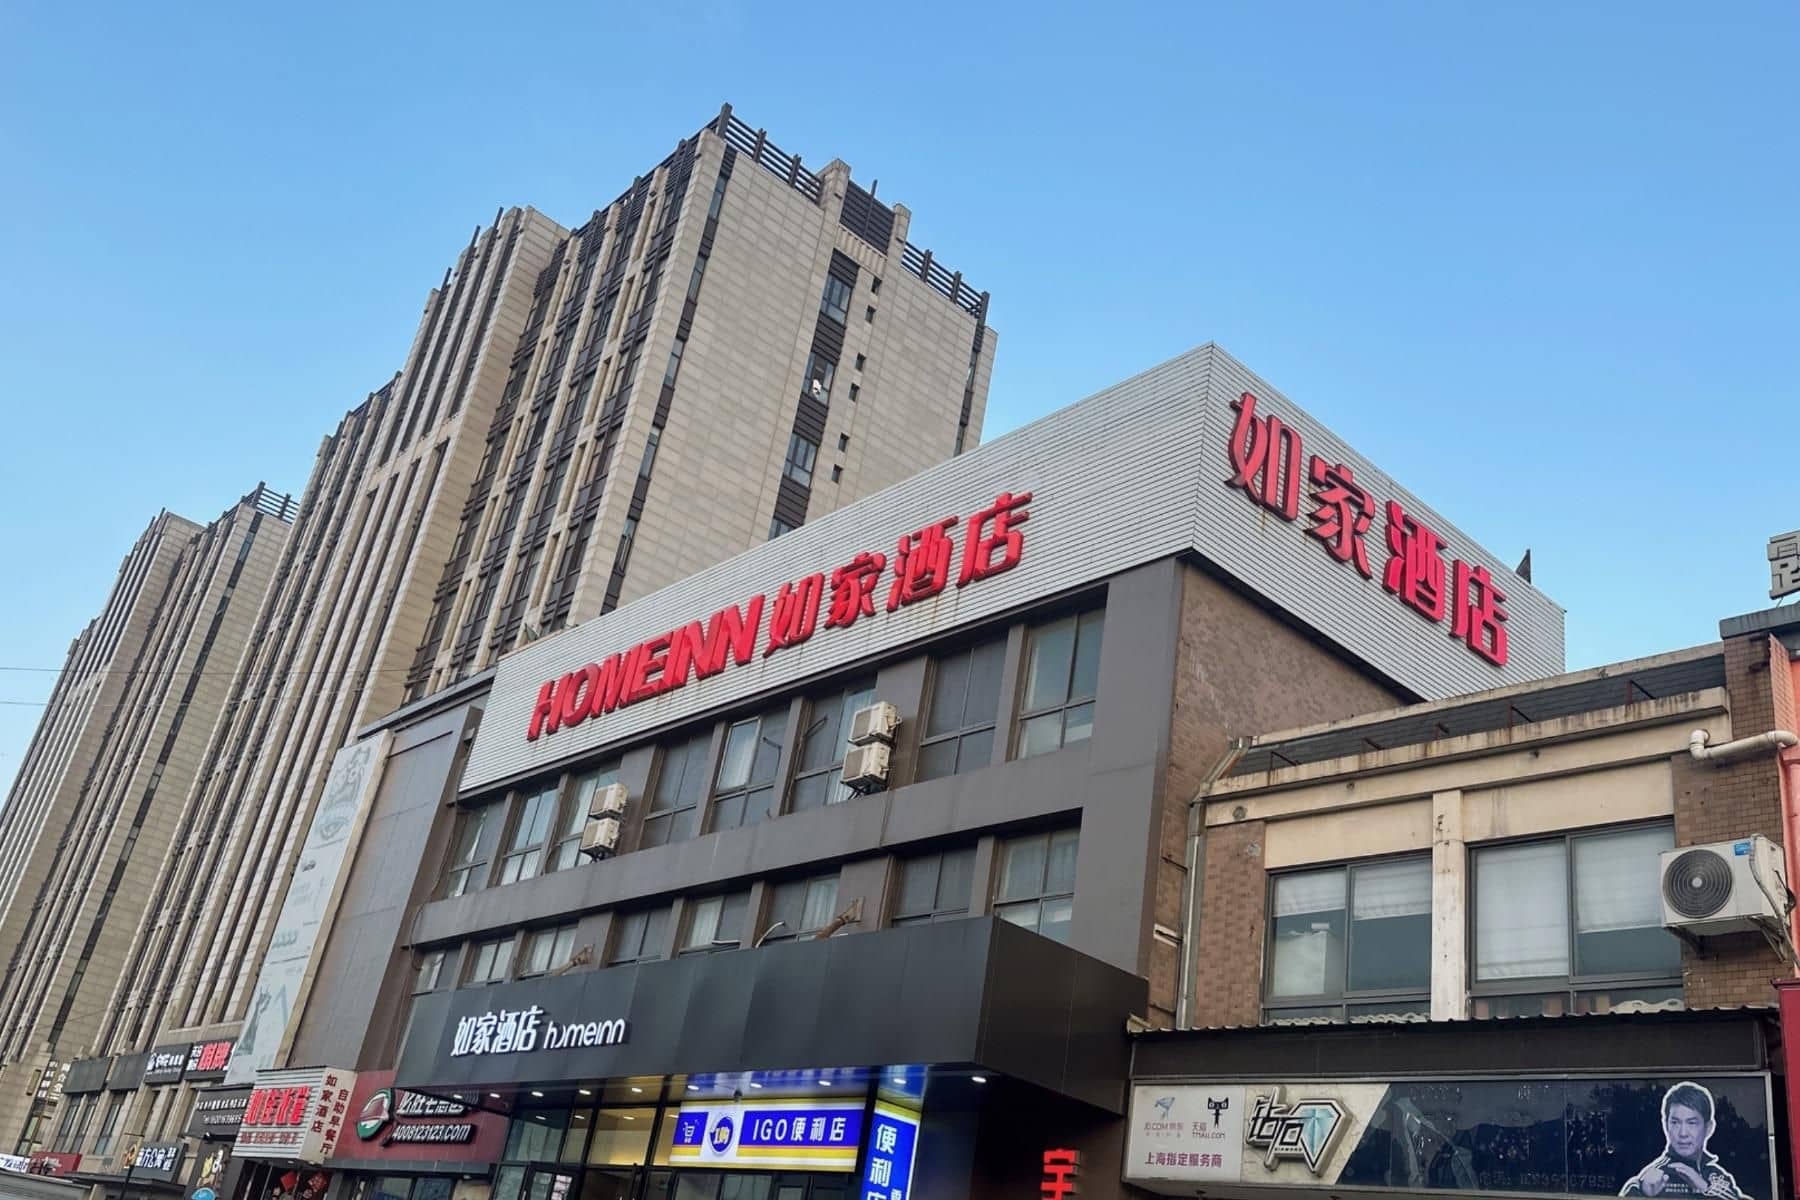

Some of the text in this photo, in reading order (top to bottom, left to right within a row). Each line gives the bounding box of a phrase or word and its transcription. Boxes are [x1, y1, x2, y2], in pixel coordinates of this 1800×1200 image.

[1225, 391, 1508, 667] 如家酒店
[762, 491, 1032, 658] 如家酒店
[450, 1005, 545, 1057] 如家酒店
[311, 1074, 337, 1134] 如家酒店
[319, 1089, 349, 1155] 自助早餐厅
[1144, 1151, 1223, 1168] 上海指定服务商
